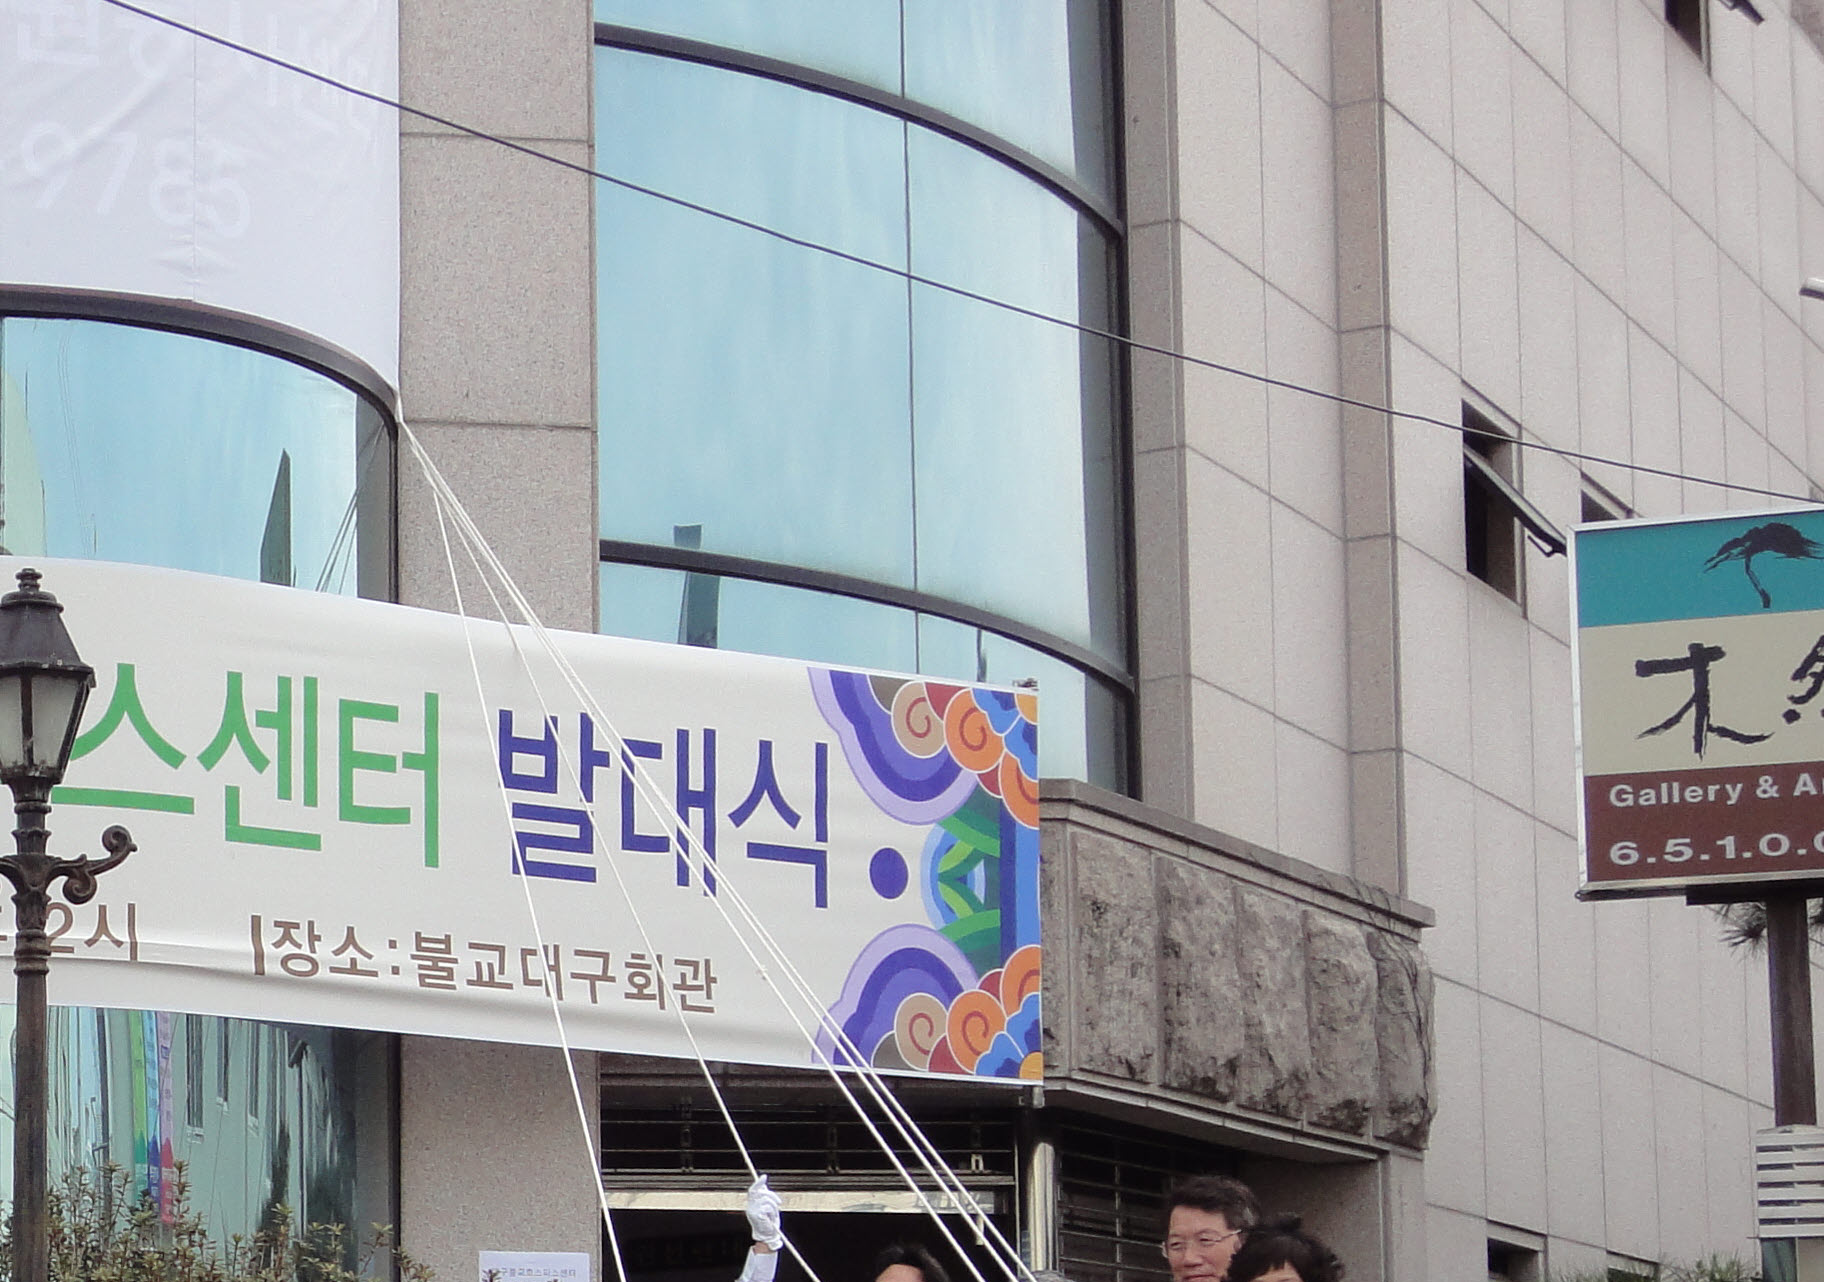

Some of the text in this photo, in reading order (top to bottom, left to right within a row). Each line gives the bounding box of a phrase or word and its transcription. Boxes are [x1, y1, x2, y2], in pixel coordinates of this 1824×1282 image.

[498, 708, 830, 909] 발대식
[1609, 772, 1824, 808] Gallery & A
[44, 901, 139, 962] 2시
